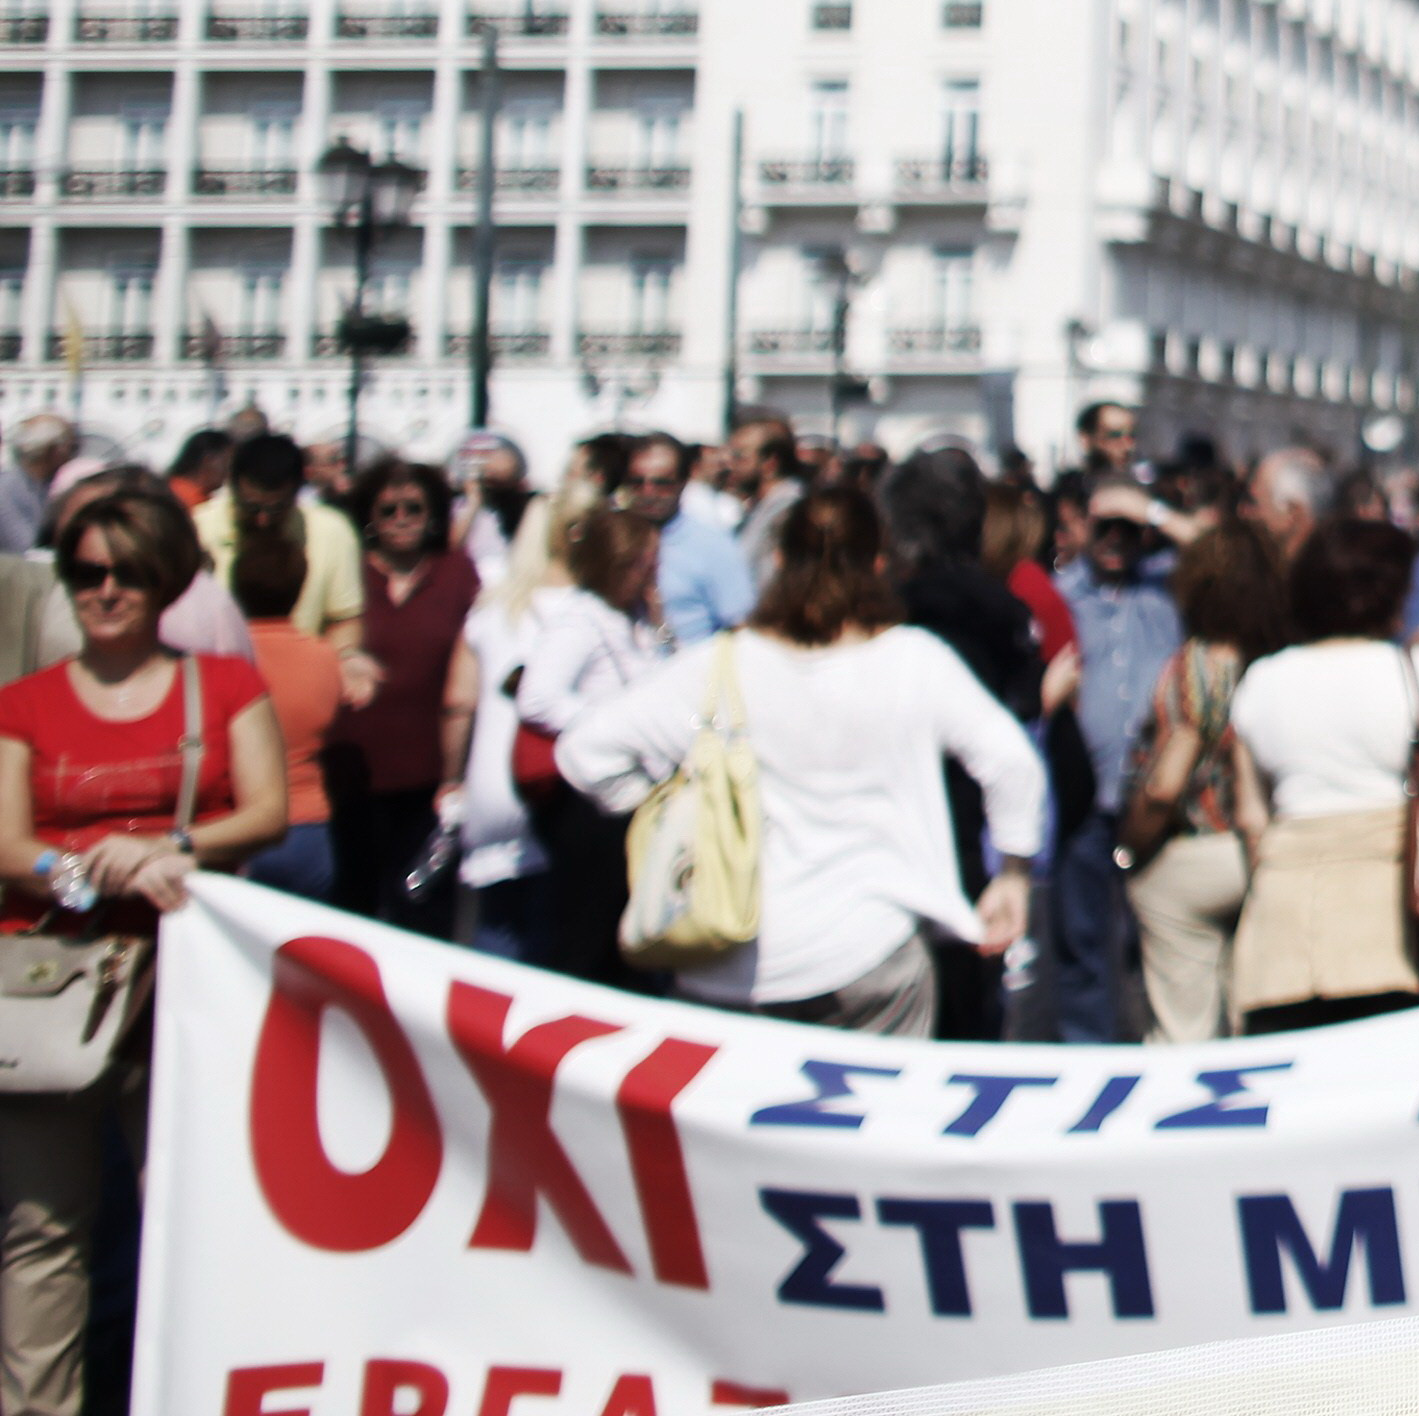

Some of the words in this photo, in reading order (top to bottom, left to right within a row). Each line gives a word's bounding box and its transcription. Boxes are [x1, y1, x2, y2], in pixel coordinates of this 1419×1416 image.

[250, 936, 721, 1291] ΟΧΙ
[750, 1060, 1295, 1136] ΣΤΙΣ
[759, 1188, 1154, 1319] ΣΤΗ
